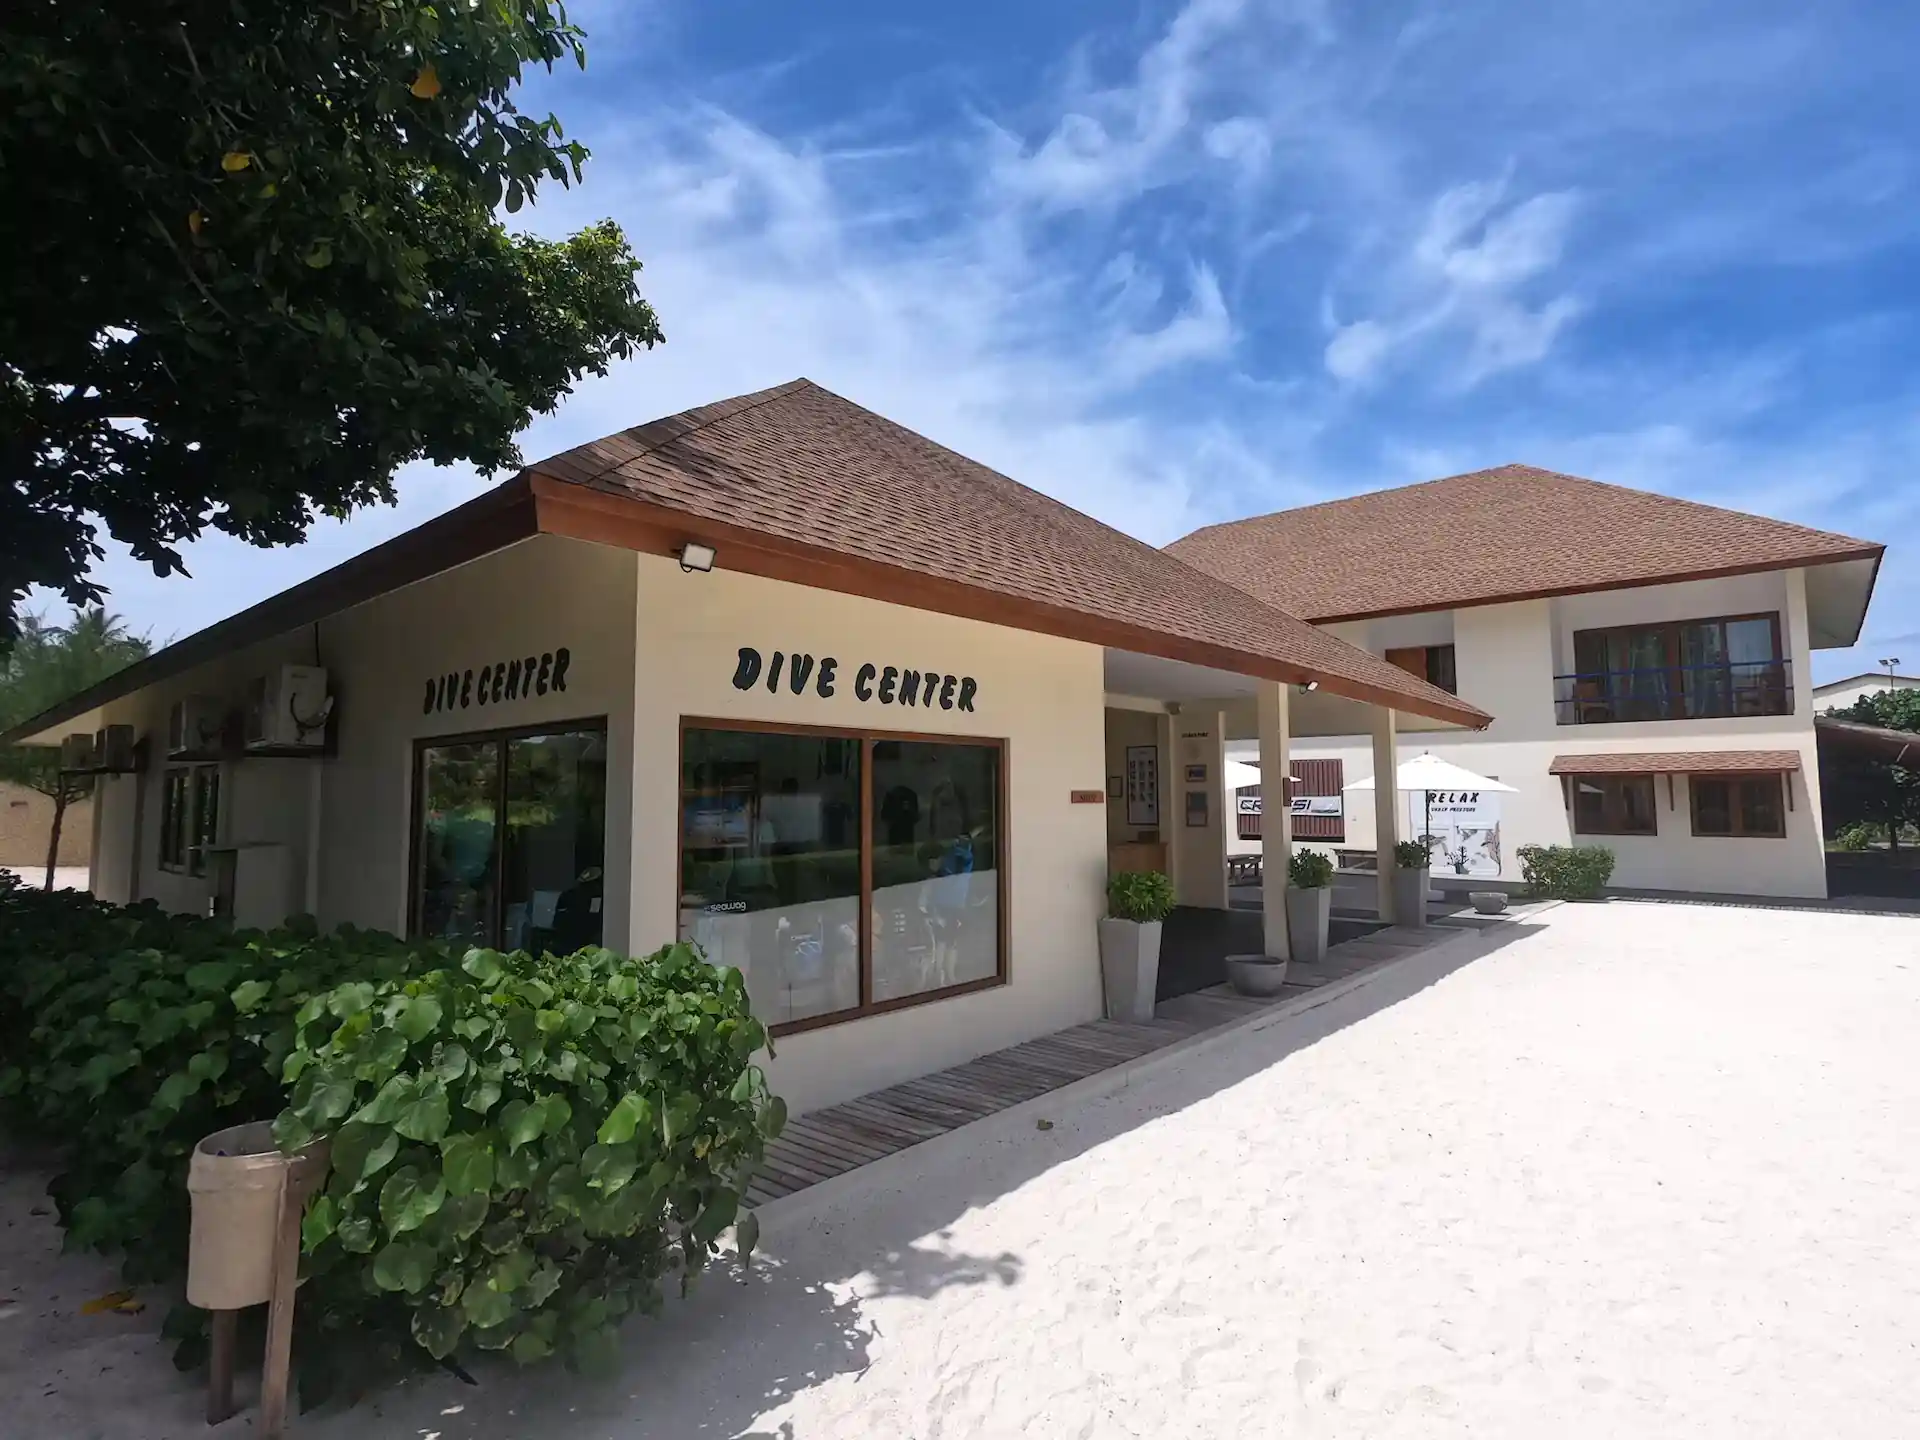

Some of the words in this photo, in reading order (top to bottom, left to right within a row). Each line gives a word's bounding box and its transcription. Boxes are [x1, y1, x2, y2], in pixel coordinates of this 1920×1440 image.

[424, 669, 473, 715] DIVE
[477, 647, 570, 706] CENTER
[732, 647, 838, 698] DIVE
[855, 663, 977, 713] CENTER
[1429, 792, 1479, 803] RELAX
